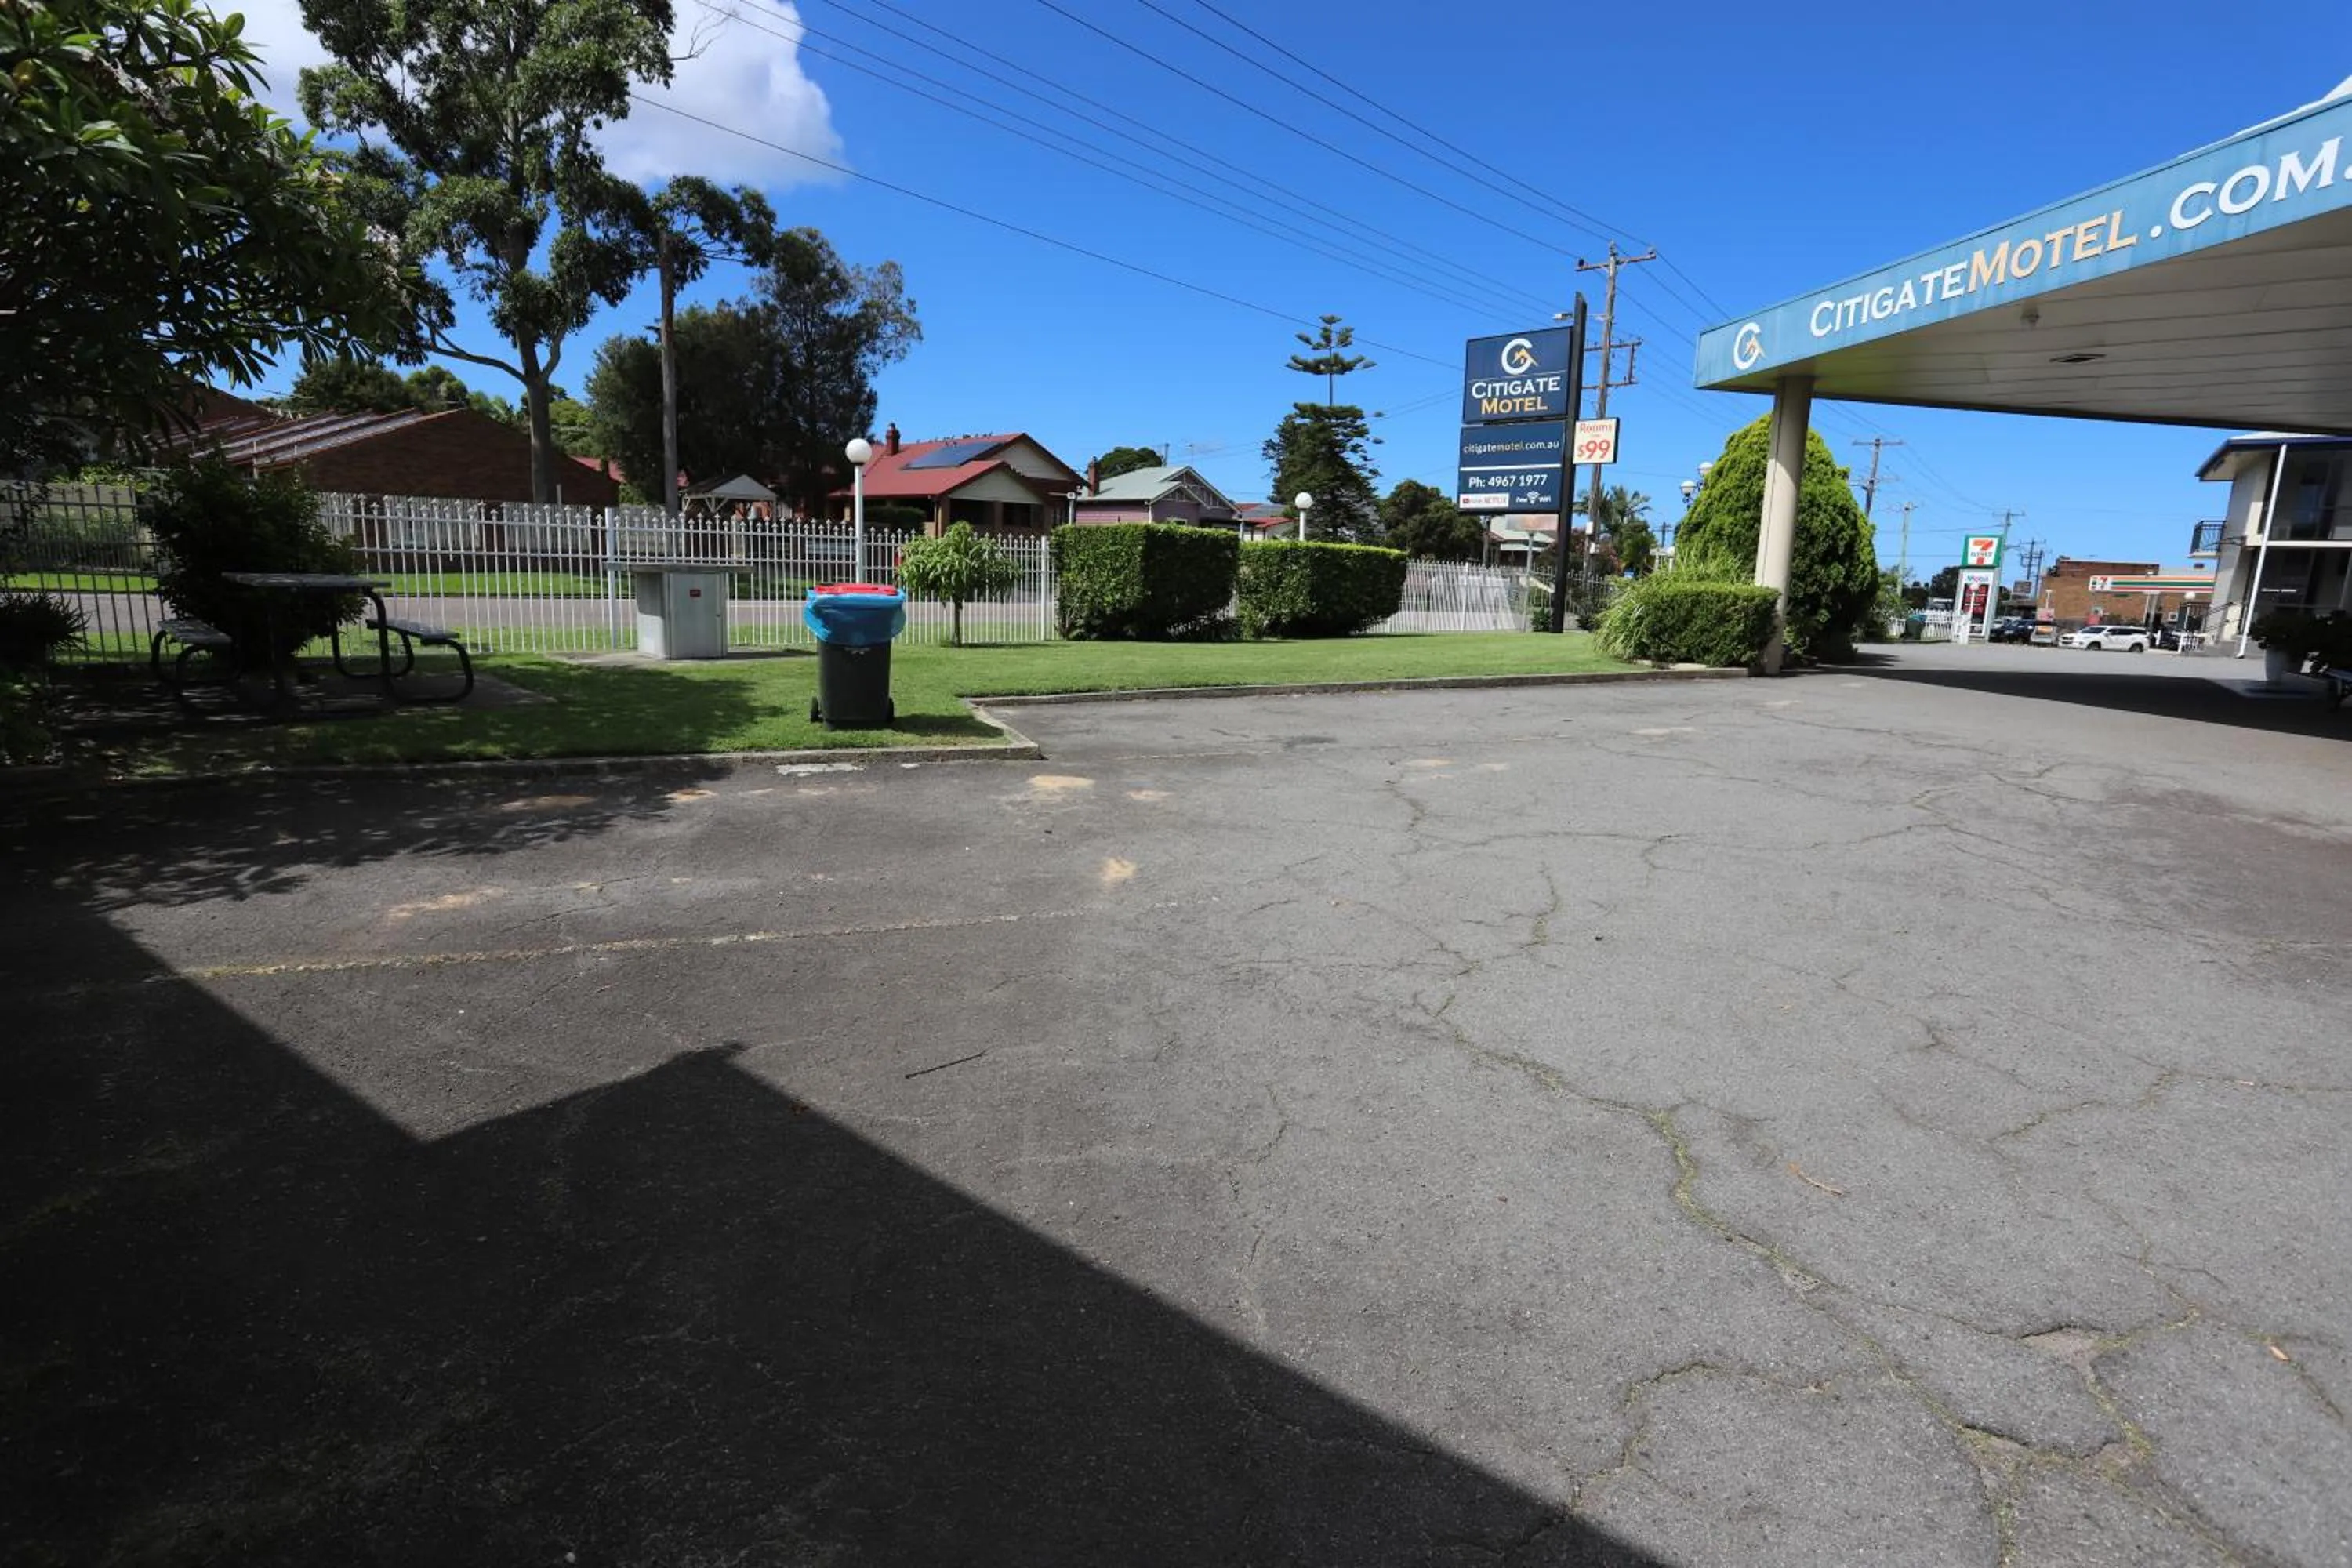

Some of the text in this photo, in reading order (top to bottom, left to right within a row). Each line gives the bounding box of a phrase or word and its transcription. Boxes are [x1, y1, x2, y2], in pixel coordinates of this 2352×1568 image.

[1472, 376, 1561, 398] CITIGATE
[1481, 397, 1548, 414] MOTEL
[1580, 423, 1612, 433] Rooms
[1464, 440, 1559, 455] citigatemotel.com.au
[1577, 439, 1610, 459] $99
[1468, 474, 1548, 488] Ph: 4967 1977
